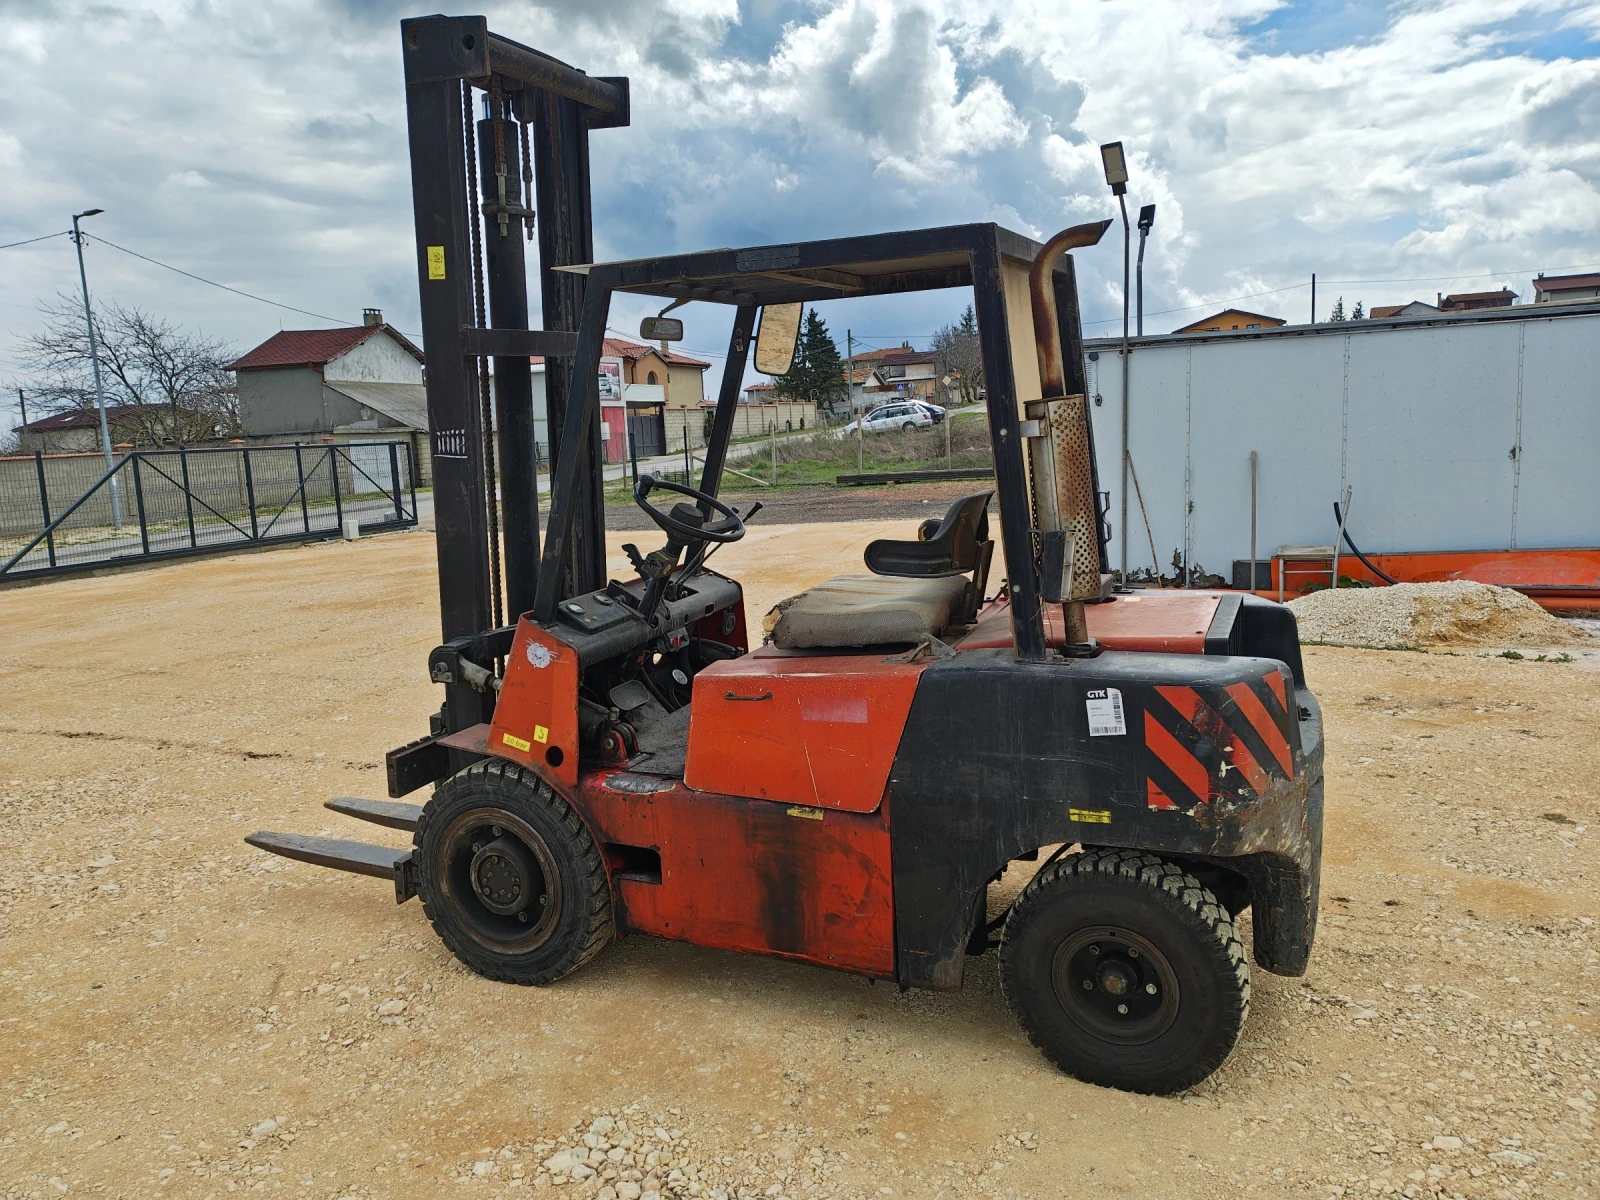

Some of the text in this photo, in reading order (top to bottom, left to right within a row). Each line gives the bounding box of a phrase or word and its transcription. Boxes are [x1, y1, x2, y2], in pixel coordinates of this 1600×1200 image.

[1087, 689, 1106, 698] GTK
[506, 737, 527, 748] 10 bar
